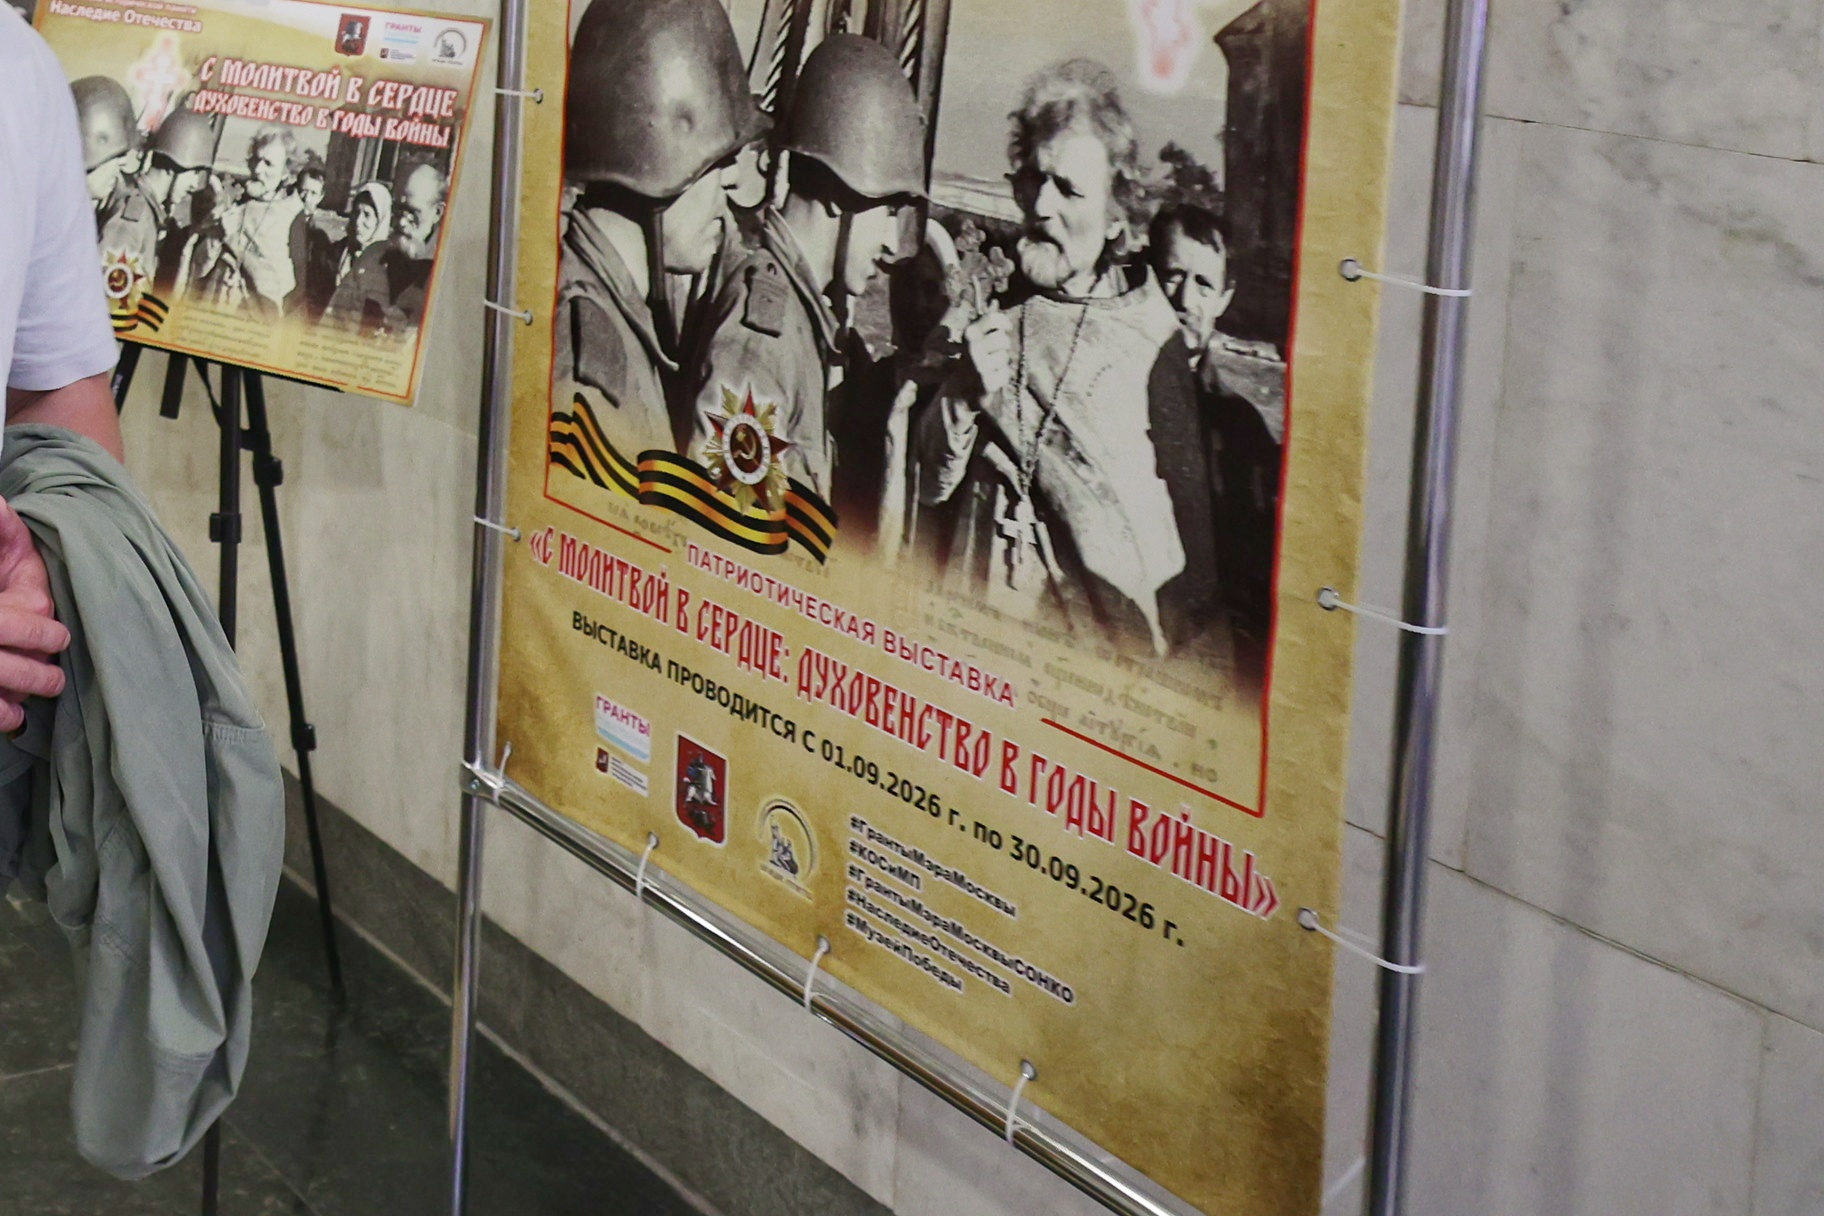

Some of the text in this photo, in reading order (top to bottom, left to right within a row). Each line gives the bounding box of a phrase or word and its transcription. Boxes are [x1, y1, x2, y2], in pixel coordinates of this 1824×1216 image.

[50, 0, 121, 22] Наследие
[125, 9, 202, 33] Отечества
[385, 22, 422, 33] ГРАНТЫ
[193, 89, 451, 148] ДУХОВЕНСТВО В ГОДЫ ВОЙНЫ
[200, 57, 457, 117] С МОЛИТВОЙ В СЕРДЦЕ
[688, 544, 875, 644] ПАТРИОТИЧЕСКАЯ
[883, 630, 1014, 708] ВЫСТАВКА
[530, 528, 554, 564] «С
[559, 533, 669, 624] МОЛИТВОЙ
[677, 588, 689, 634] В
[696, 600, 790, 683] СЕРДЦЕ:
[797, 647, 991, 778] ДУХОВЕНСТВО
[1001, 739, 1019, 795] В
[1029, 753, 1117, 844] ГОДЫ
[1127, 798, 1278, 919] ВОЙНЫ»
[597, 697, 650, 737] ГРАНТЫ
[573, 611, 1184, 946] ВЫСТАВКА ПРОВОДИТСЯ С 01.09.2026 г. по 30.09.2026 г.
[851, 817, 1016, 917] #ГрантыМэраМосквы
[846, 913, 962, 991] #МузейПобеды
[848, 890, 1010, 994] #НаследиеОтечества
[849, 865, 1073, 1003] #ГрантыМэраМосквыСОНКО
